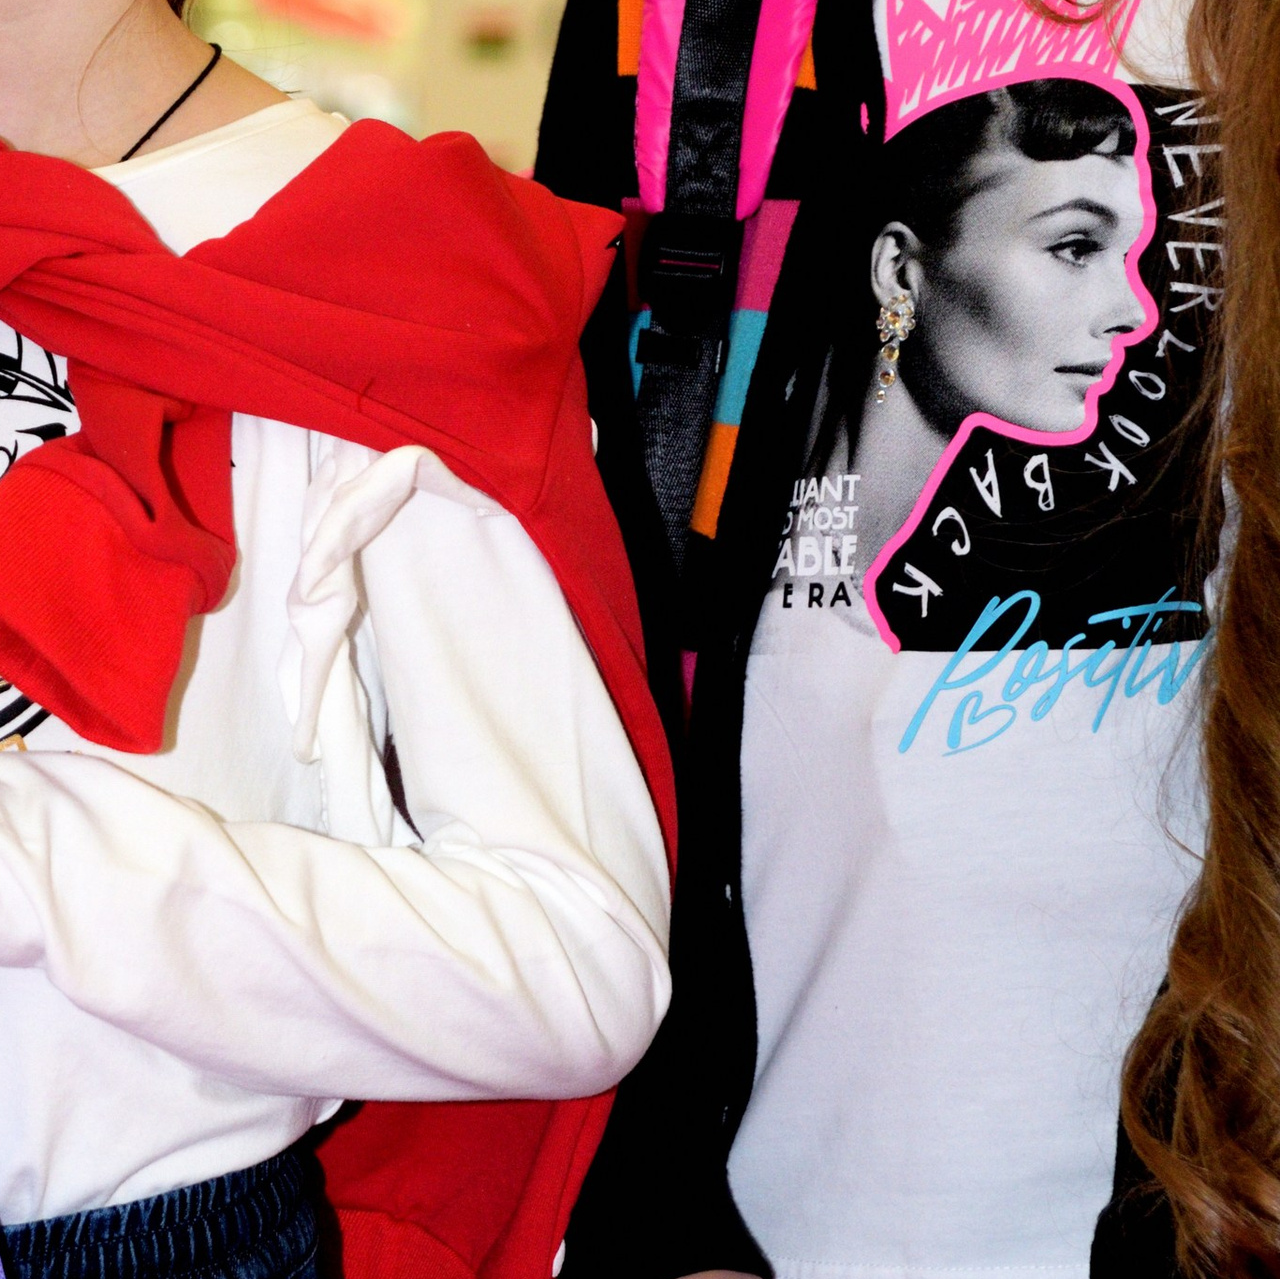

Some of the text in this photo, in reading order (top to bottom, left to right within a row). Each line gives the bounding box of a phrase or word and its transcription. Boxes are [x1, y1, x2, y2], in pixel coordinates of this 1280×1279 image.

[892, 96, 1228, 618] NEVER LOOK BACK
[796, 505, 860, 532] MOST
[771, 534, 858, 580] ABLE
